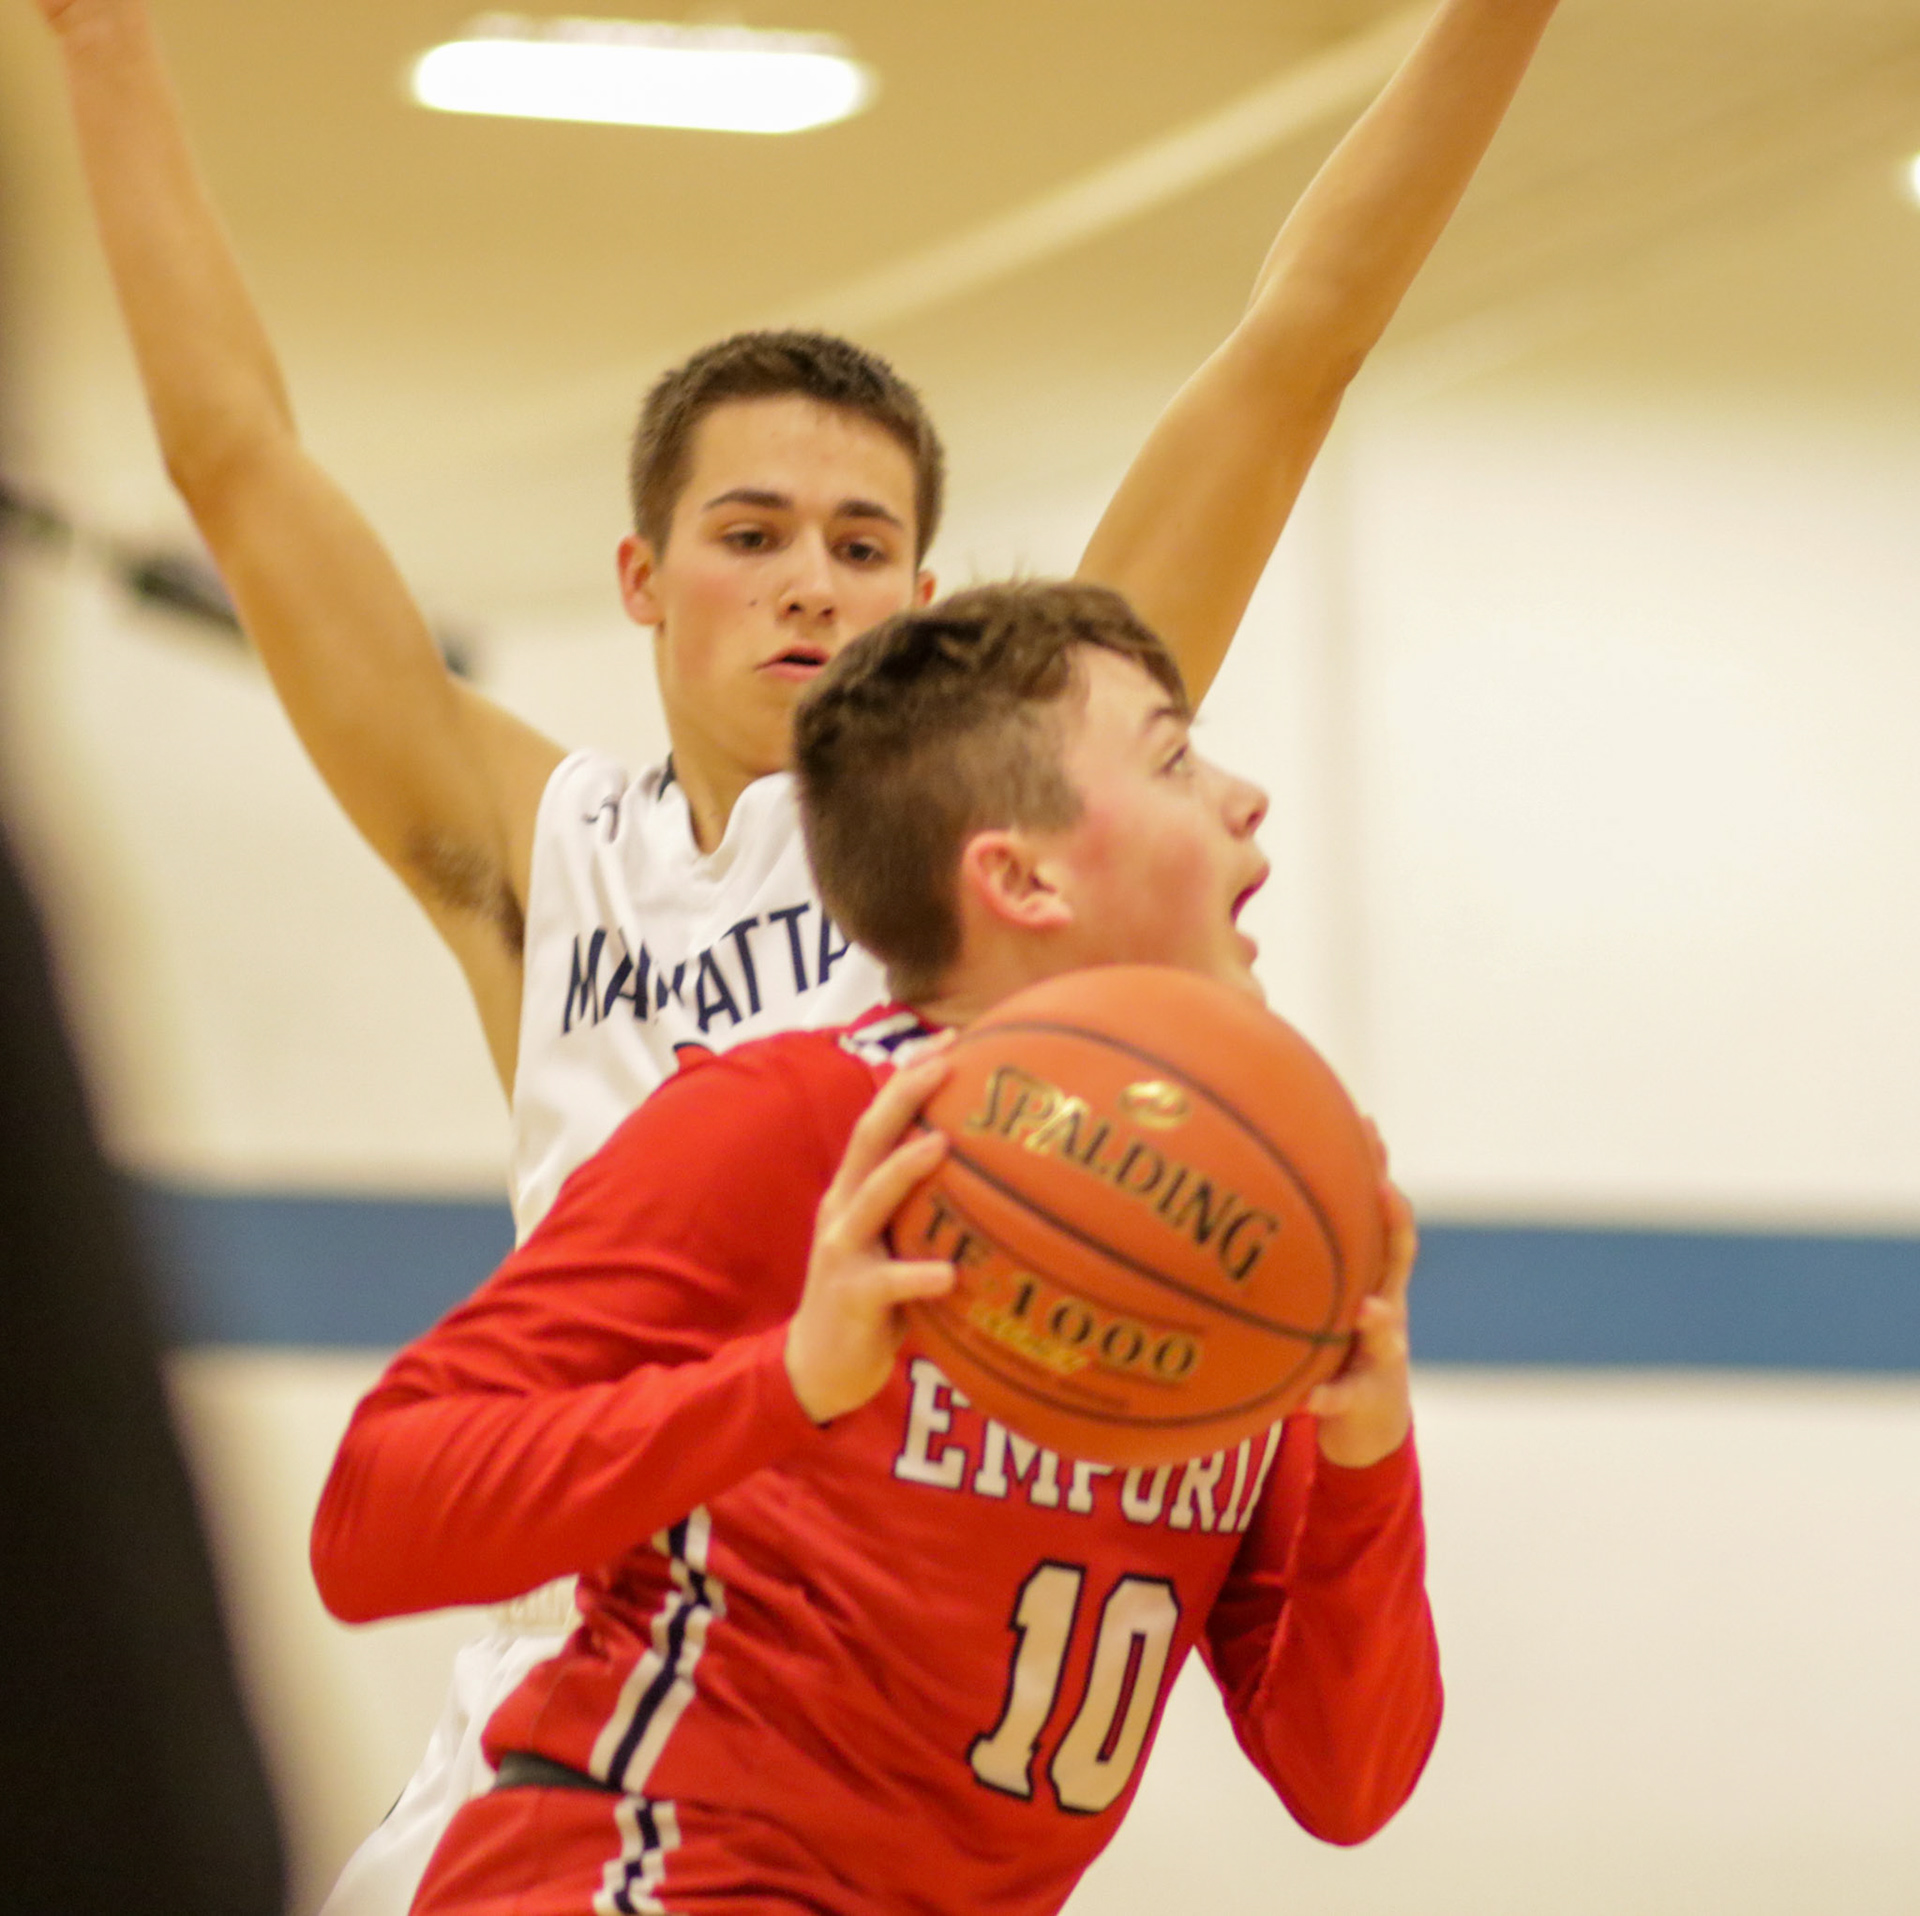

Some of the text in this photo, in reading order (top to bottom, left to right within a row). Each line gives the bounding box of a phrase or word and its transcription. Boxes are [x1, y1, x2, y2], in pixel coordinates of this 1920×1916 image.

[965, 1065, 1278, 1282] SPALDING
[1009, 1274, 1199, 1380] 1000
[968, 1558, 1181, 1815] 10
